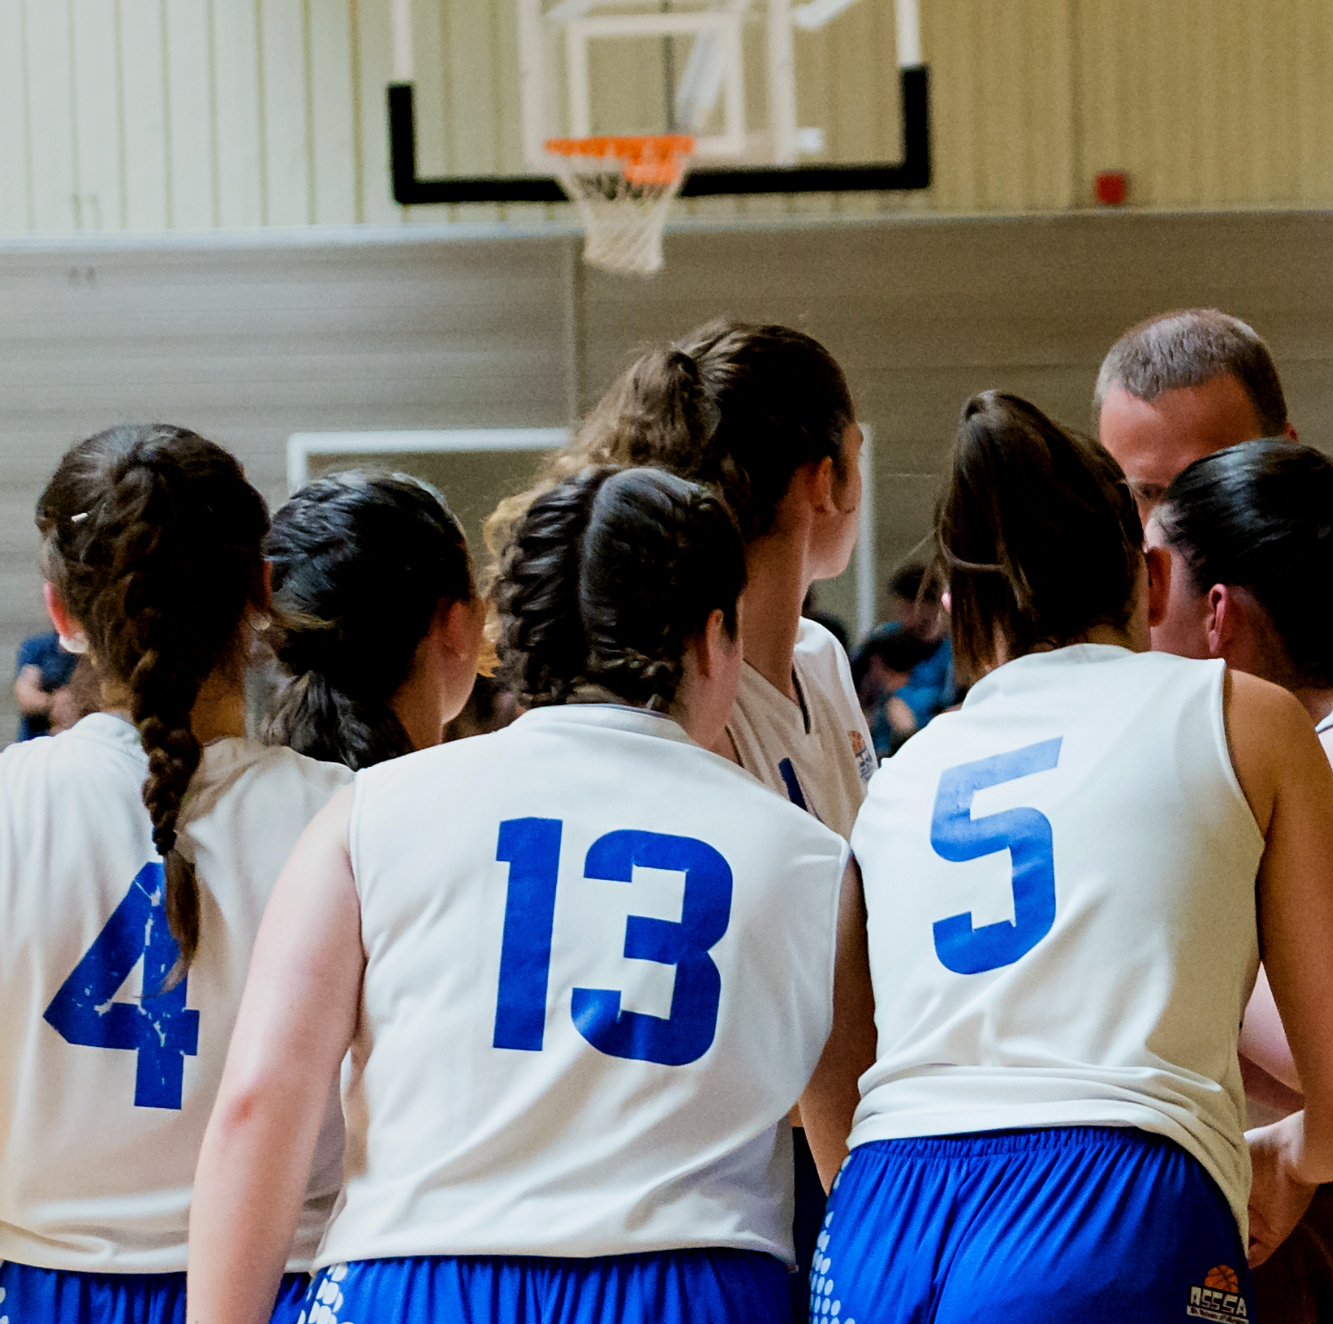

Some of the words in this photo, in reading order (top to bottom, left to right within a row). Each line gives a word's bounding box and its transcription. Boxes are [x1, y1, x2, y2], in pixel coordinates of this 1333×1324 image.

[492, 816, 734, 1067] 13
[931, 736, 1064, 976] 5
[43, 861, 199, 1110] 4
